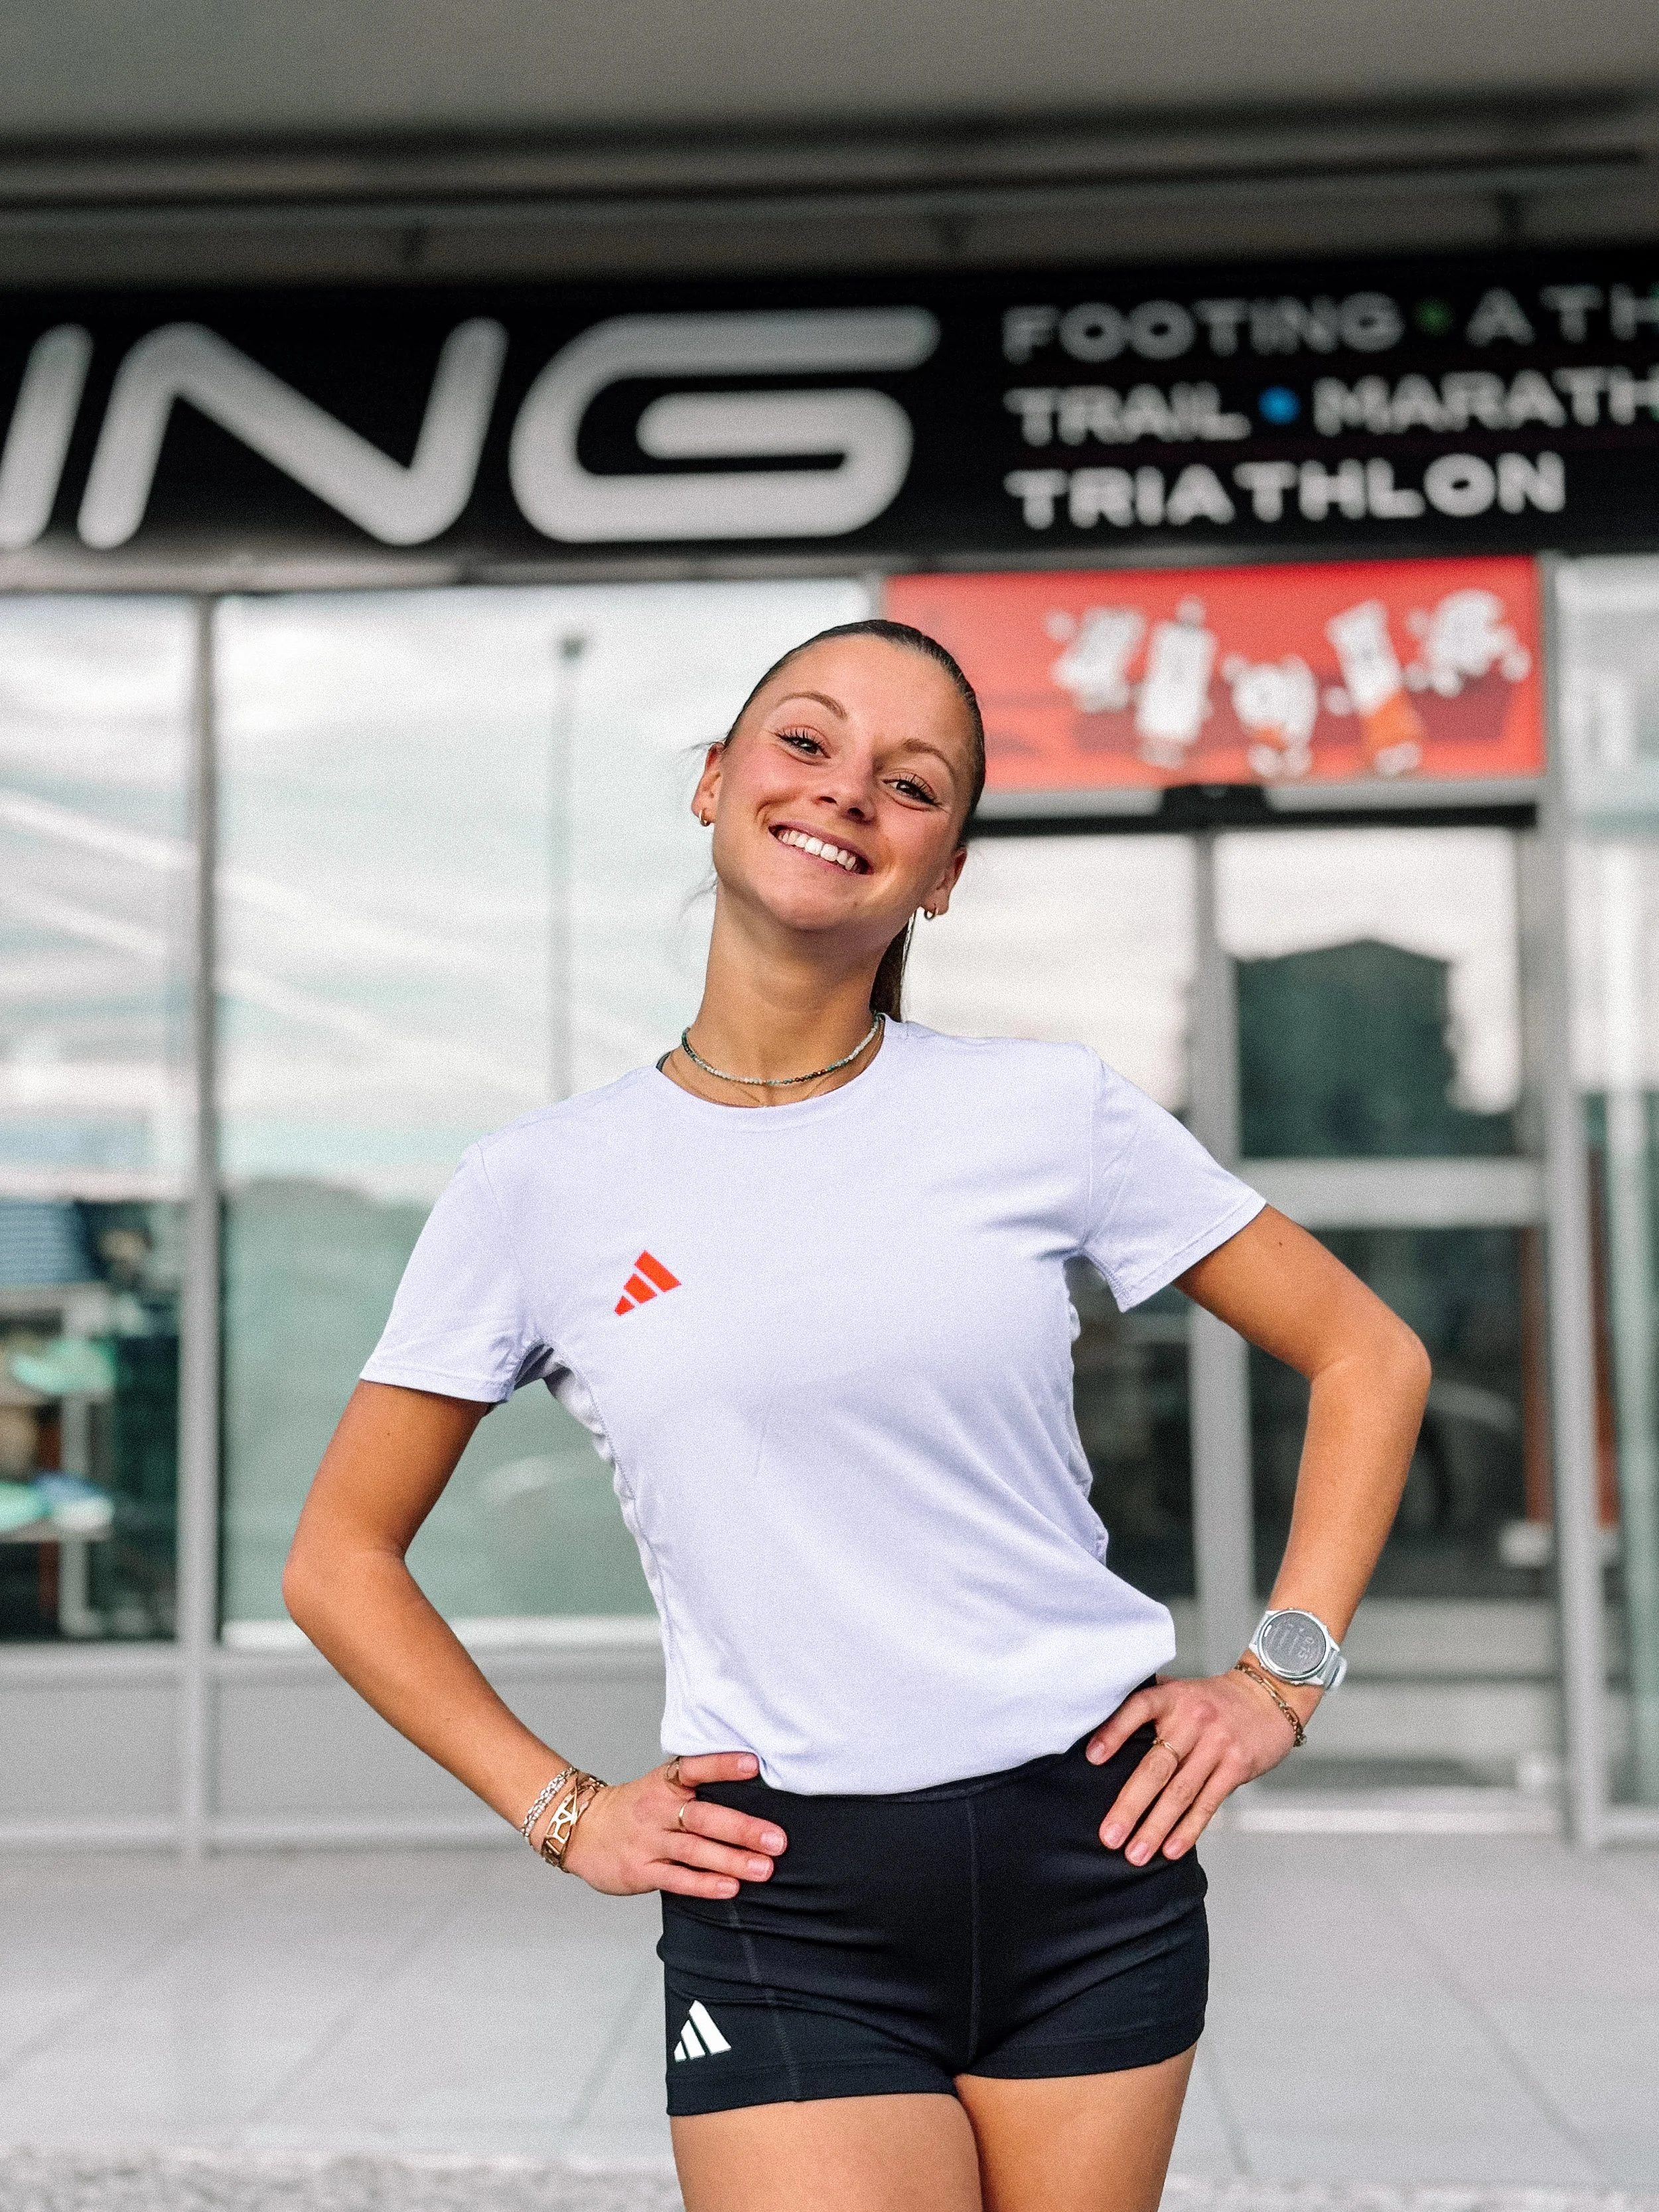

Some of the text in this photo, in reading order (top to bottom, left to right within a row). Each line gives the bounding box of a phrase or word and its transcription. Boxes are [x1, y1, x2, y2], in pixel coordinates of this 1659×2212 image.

[1003, 293, 1404, 363] FOOTING
[0, 307, 938, 548] ING
[1003, 382, 1252, 447] TRAIL
[1004, 451, 1566, 530] TRIATHLON
